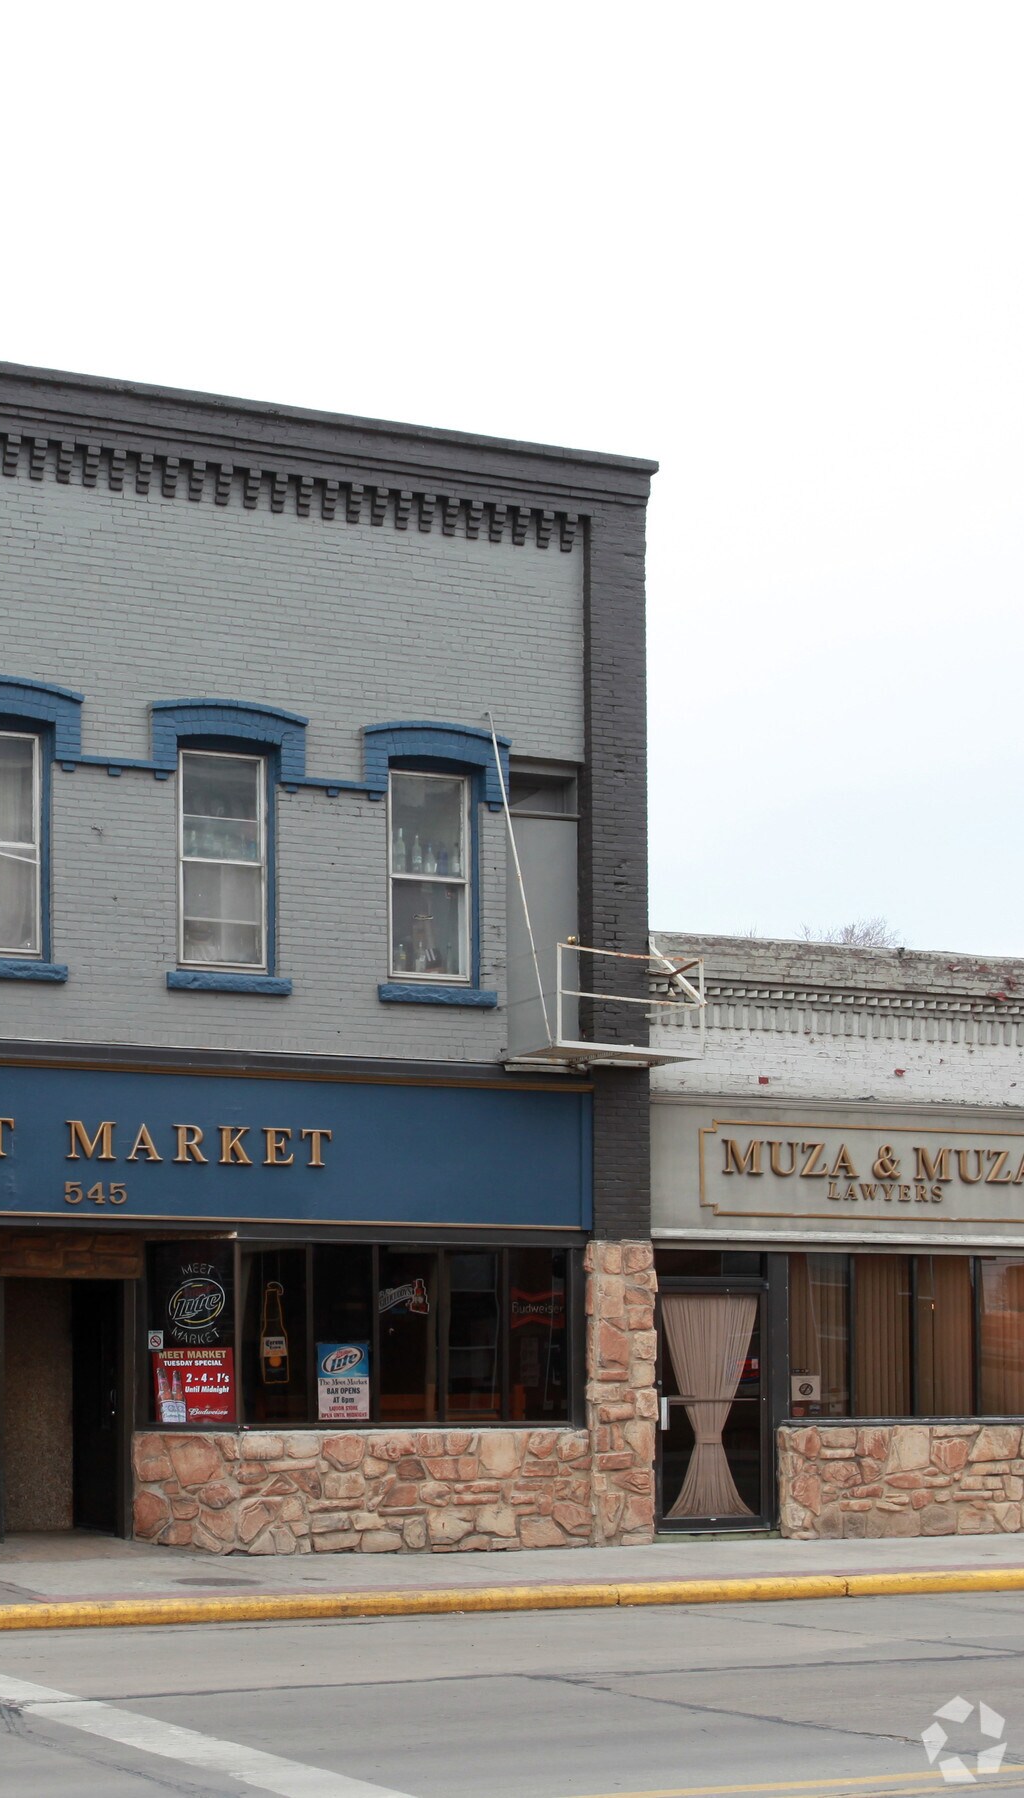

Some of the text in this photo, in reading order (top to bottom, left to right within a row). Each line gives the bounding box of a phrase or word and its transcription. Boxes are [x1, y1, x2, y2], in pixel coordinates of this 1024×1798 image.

[65, 1120, 333, 1167] MARKET
[721, 1138, 860, 1179] MUZA
[872, 1144, 902, 1180] &
[64, 1181, 128, 1204] 545
[827, 1181, 944, 1203] LAWYERS
[180, 1262, 215, 1275] MEET
[172, 1293, 221, 1320] Lite
[512, 1301, 564, 1314] Budweiser
[171, 1327, 221, 1344] MARKET
[159, 1350, 227, 1359] MEET MARKET
[201, 1385, 230, 1394] Midnight
[326, 1387, 361, 1395] BAR OPENS
[188, 1407, 229, 1416] Budweiser
